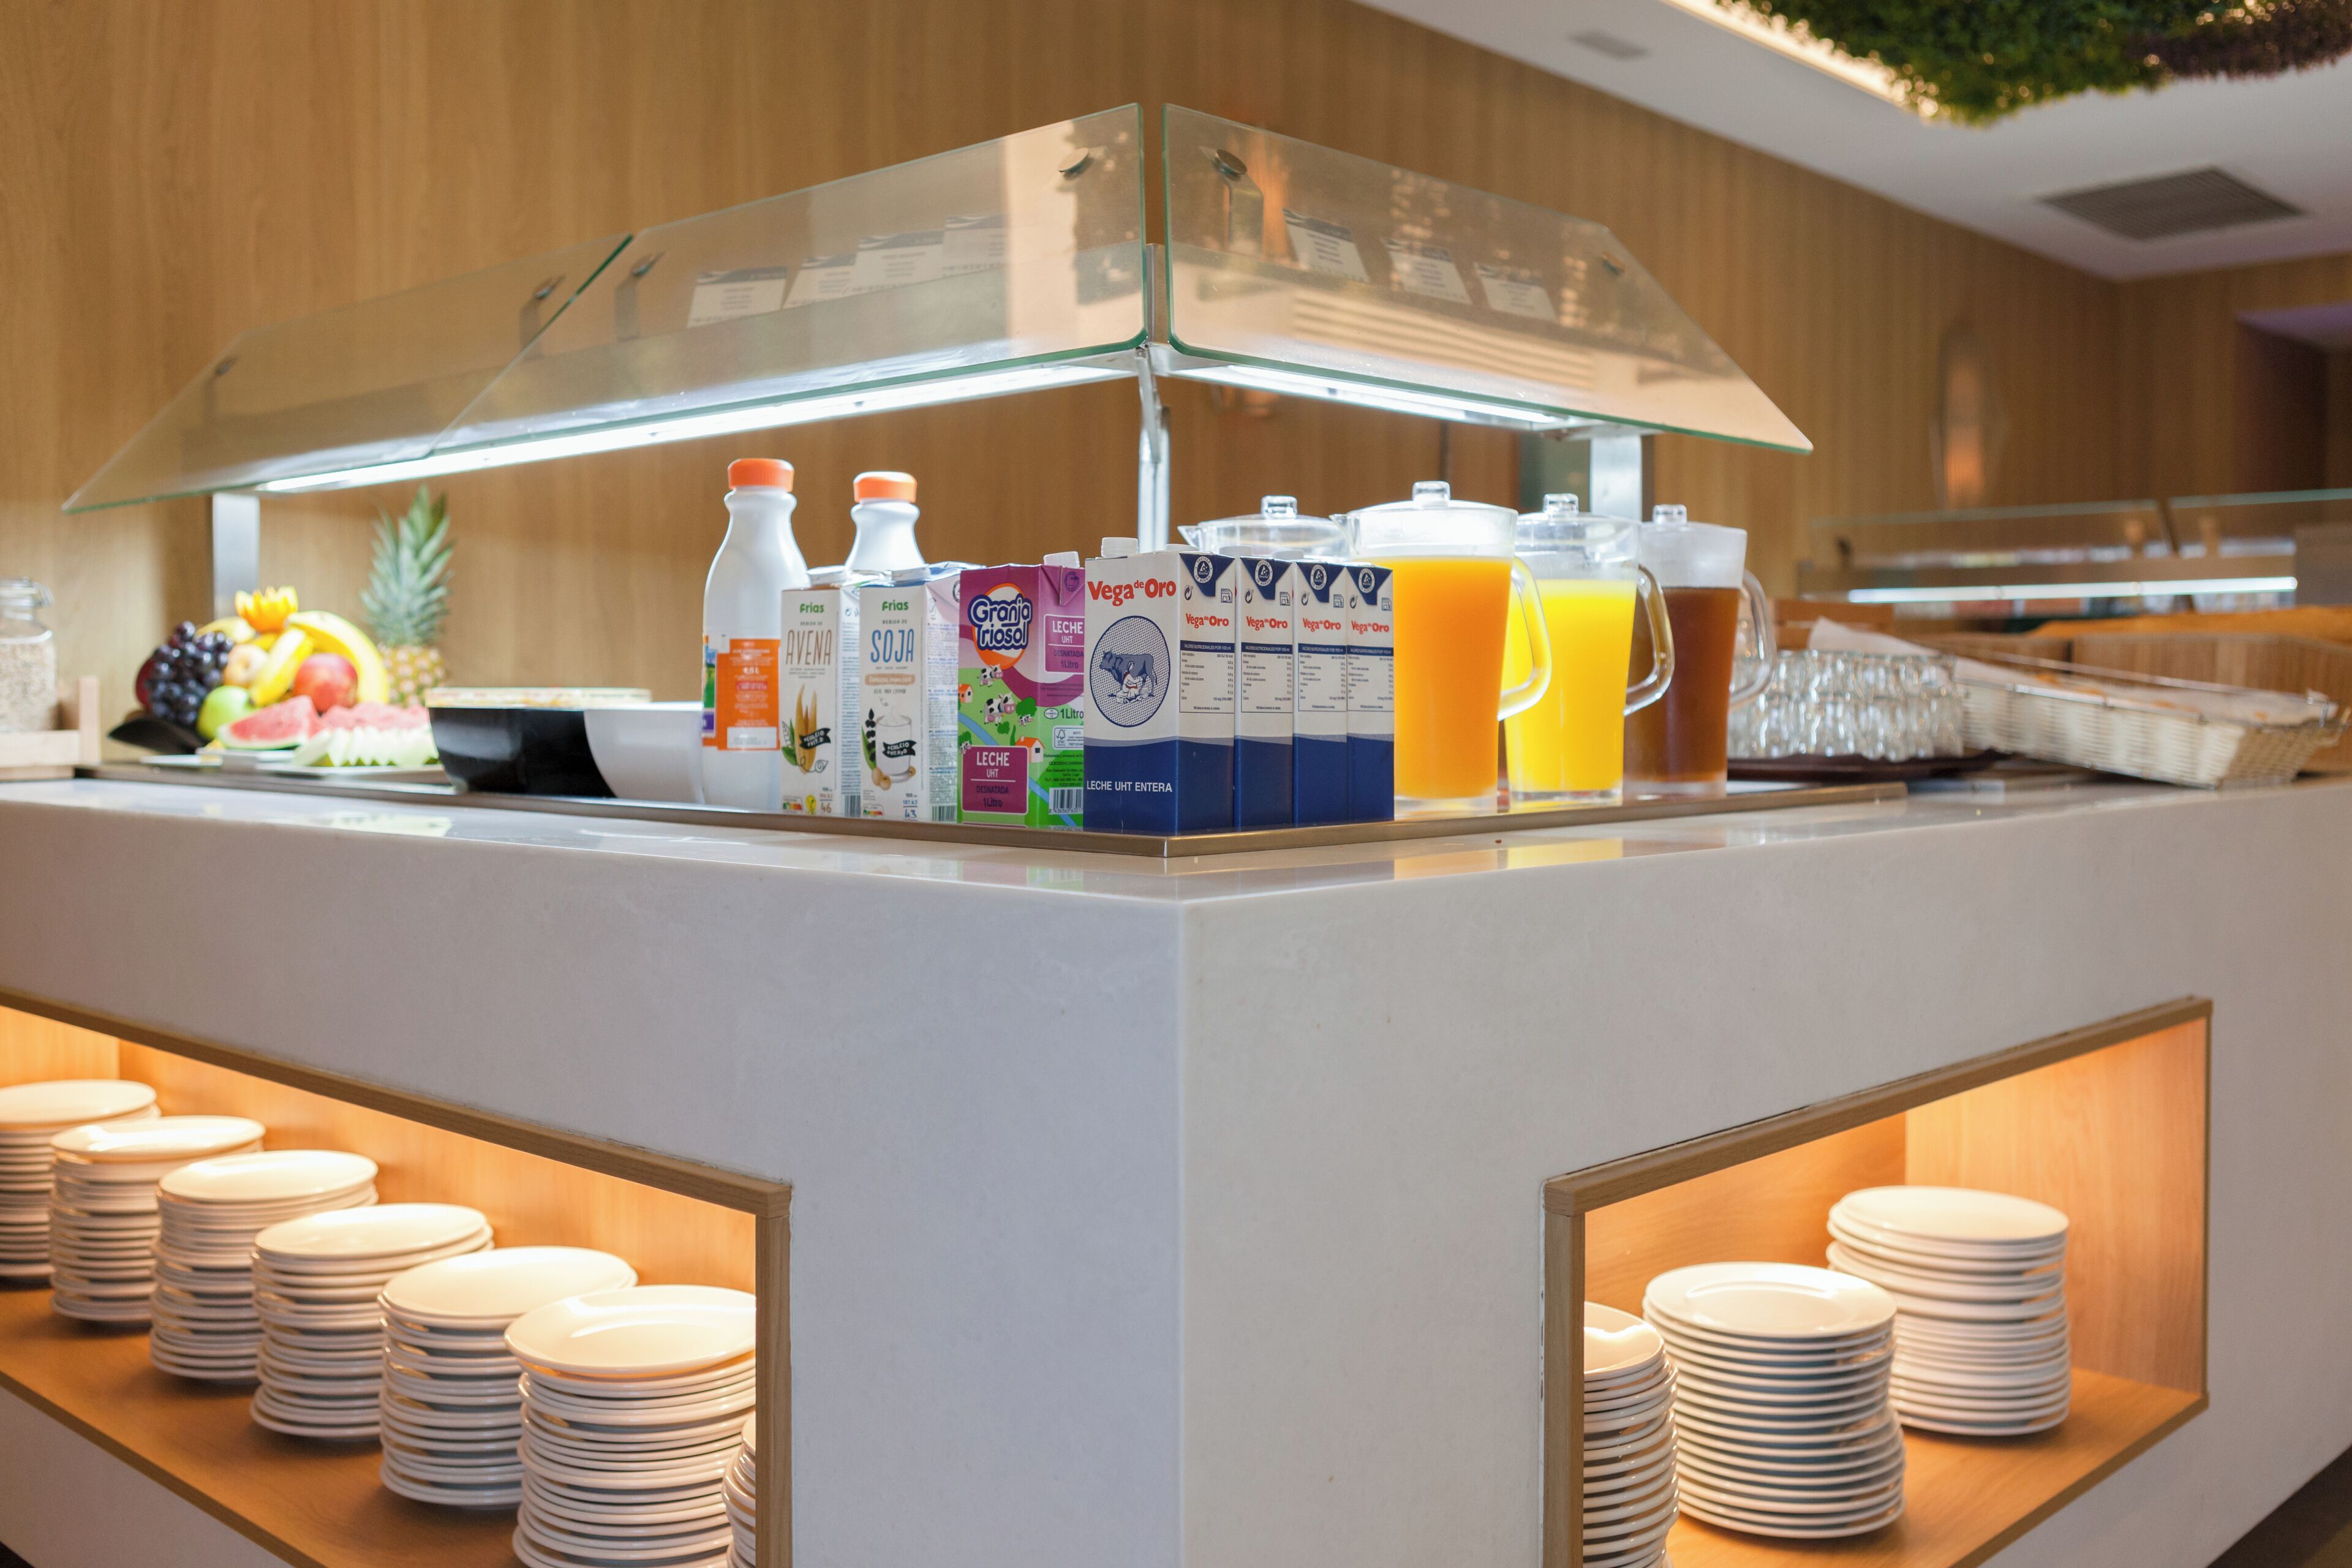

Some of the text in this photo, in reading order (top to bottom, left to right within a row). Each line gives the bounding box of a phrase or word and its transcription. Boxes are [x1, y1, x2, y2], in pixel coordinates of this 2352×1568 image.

[1087, 581, 1134, 607] Vega
[1134, 580, 1144, 589] de
[1145, 578, 1177, 598] Oro
[970, 597, 1031, 627] Granja
[1052, 620, 1084, 634] LECHE
[1186, 613, 1204, 629] Vega
[1209, 616, 1229, 627] Oro
[1246, 616, 1264, 631] Vega
[1269, 618, 1288, 628] Oro
[1303, 618, 1319, 632] Vega
[1324, 620, 1341, 630] Oro
[1351, 620, 1368, 635] Vega
[1372, 623, 1390, 633] Oro
[870, 628, 914, 663] SOJA
[1061, 635, 1073, 644] UHT
[786, 629, 832, 665] AVENA
[976, 752, 1010, 767] LECHE
[987, 769, 999, 778] UHT
[976, 785, 1009, 794] DESNATADA
[1087, 780, 1173, 793] LECHE UHT ENTERA
[821, 802, 832, 813] 46
[905, 809, 917, 818] 43
